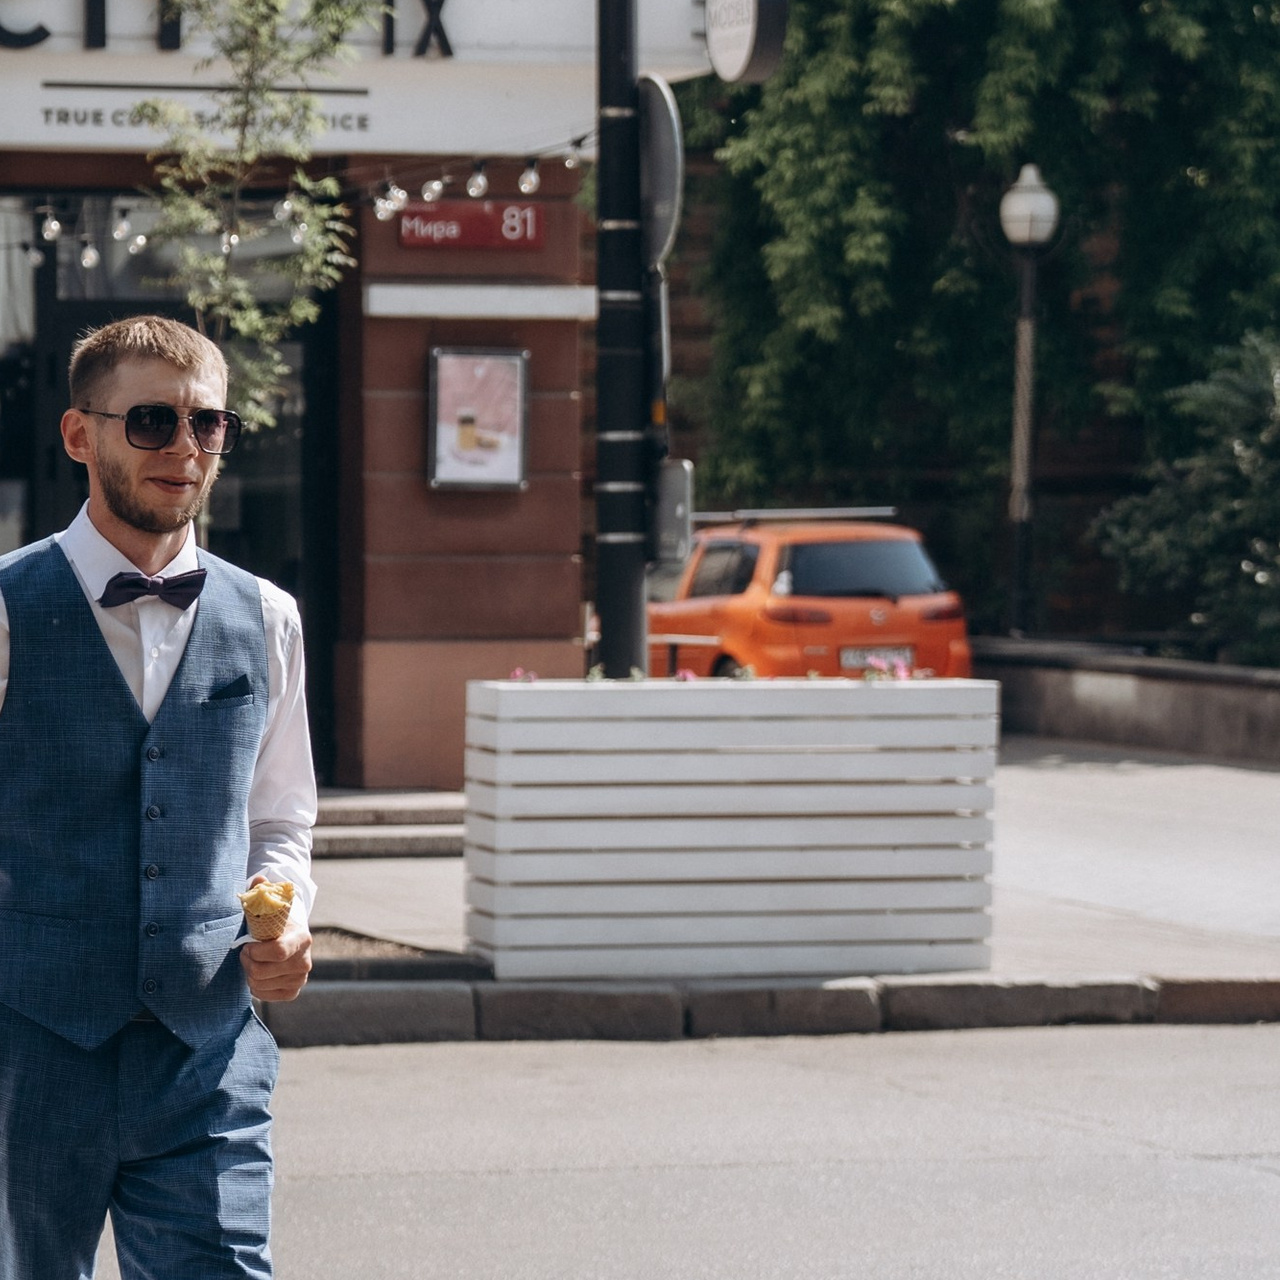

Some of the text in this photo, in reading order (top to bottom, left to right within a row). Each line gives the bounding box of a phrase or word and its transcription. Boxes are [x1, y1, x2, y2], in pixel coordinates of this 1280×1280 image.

[41, 108, 104, 127] TRUE
[402, 205, 536, 243] Мира 81
